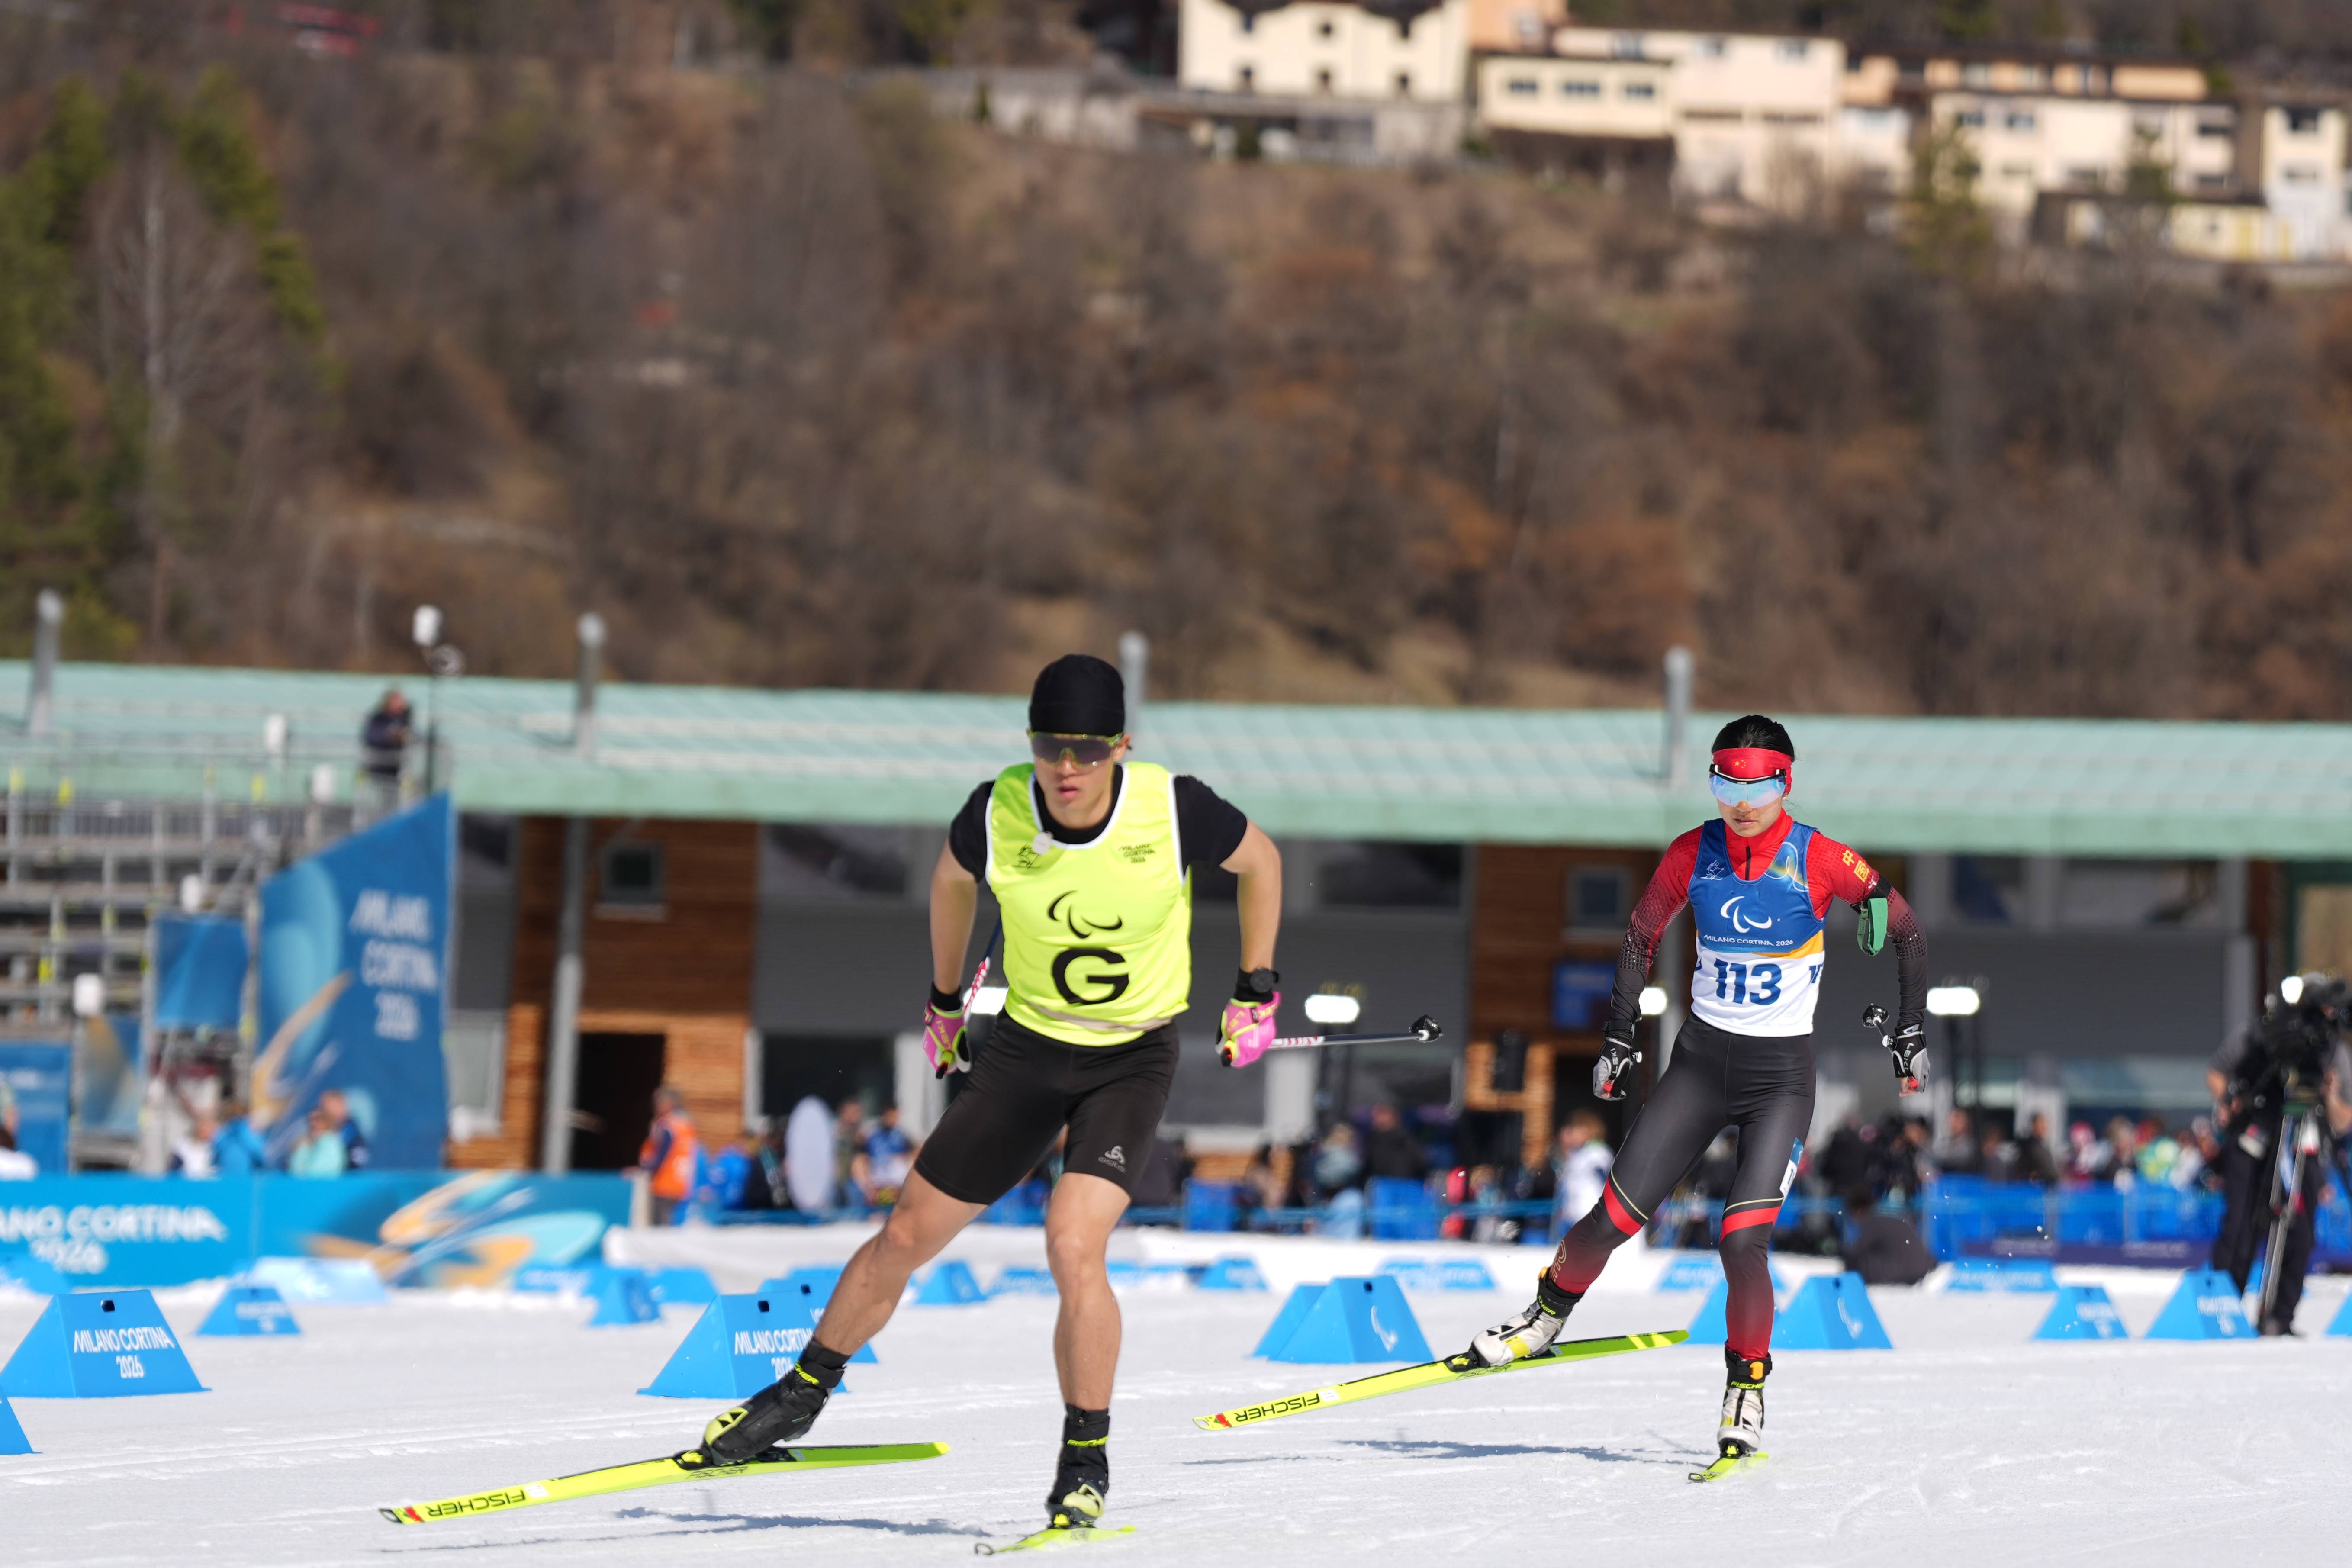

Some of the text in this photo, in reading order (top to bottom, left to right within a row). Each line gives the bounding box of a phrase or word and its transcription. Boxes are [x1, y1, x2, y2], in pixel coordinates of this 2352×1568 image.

[1118, 843, 1150, 851] MILANO
[1123, 848, 1156, 858] CORTINA
[1703, 934, 1736, 943] MILANO
[1051, 947, 1129, 1005] G
[1714, 957, 1782, 1005] 113
[1610, 1048, 1618, 1074] LEKI
[1904, 1042, 1914, 1070] LEKI
[67, 1204, 229, 1242] CORTINA
[74, 1327, 175, 1353] MILANO CORTINA
[734, 1328, 813, 1355] MILANO CORTIN
[116, 1355, 144, 1379] 2026
[771, 1356, 793, 1381] 202
[1234, 1393, 1320, 1422] FISCHER
[685, 1466, 748, 1480] FISCHER
[425, 1489, 526, 1517] FISCHER
